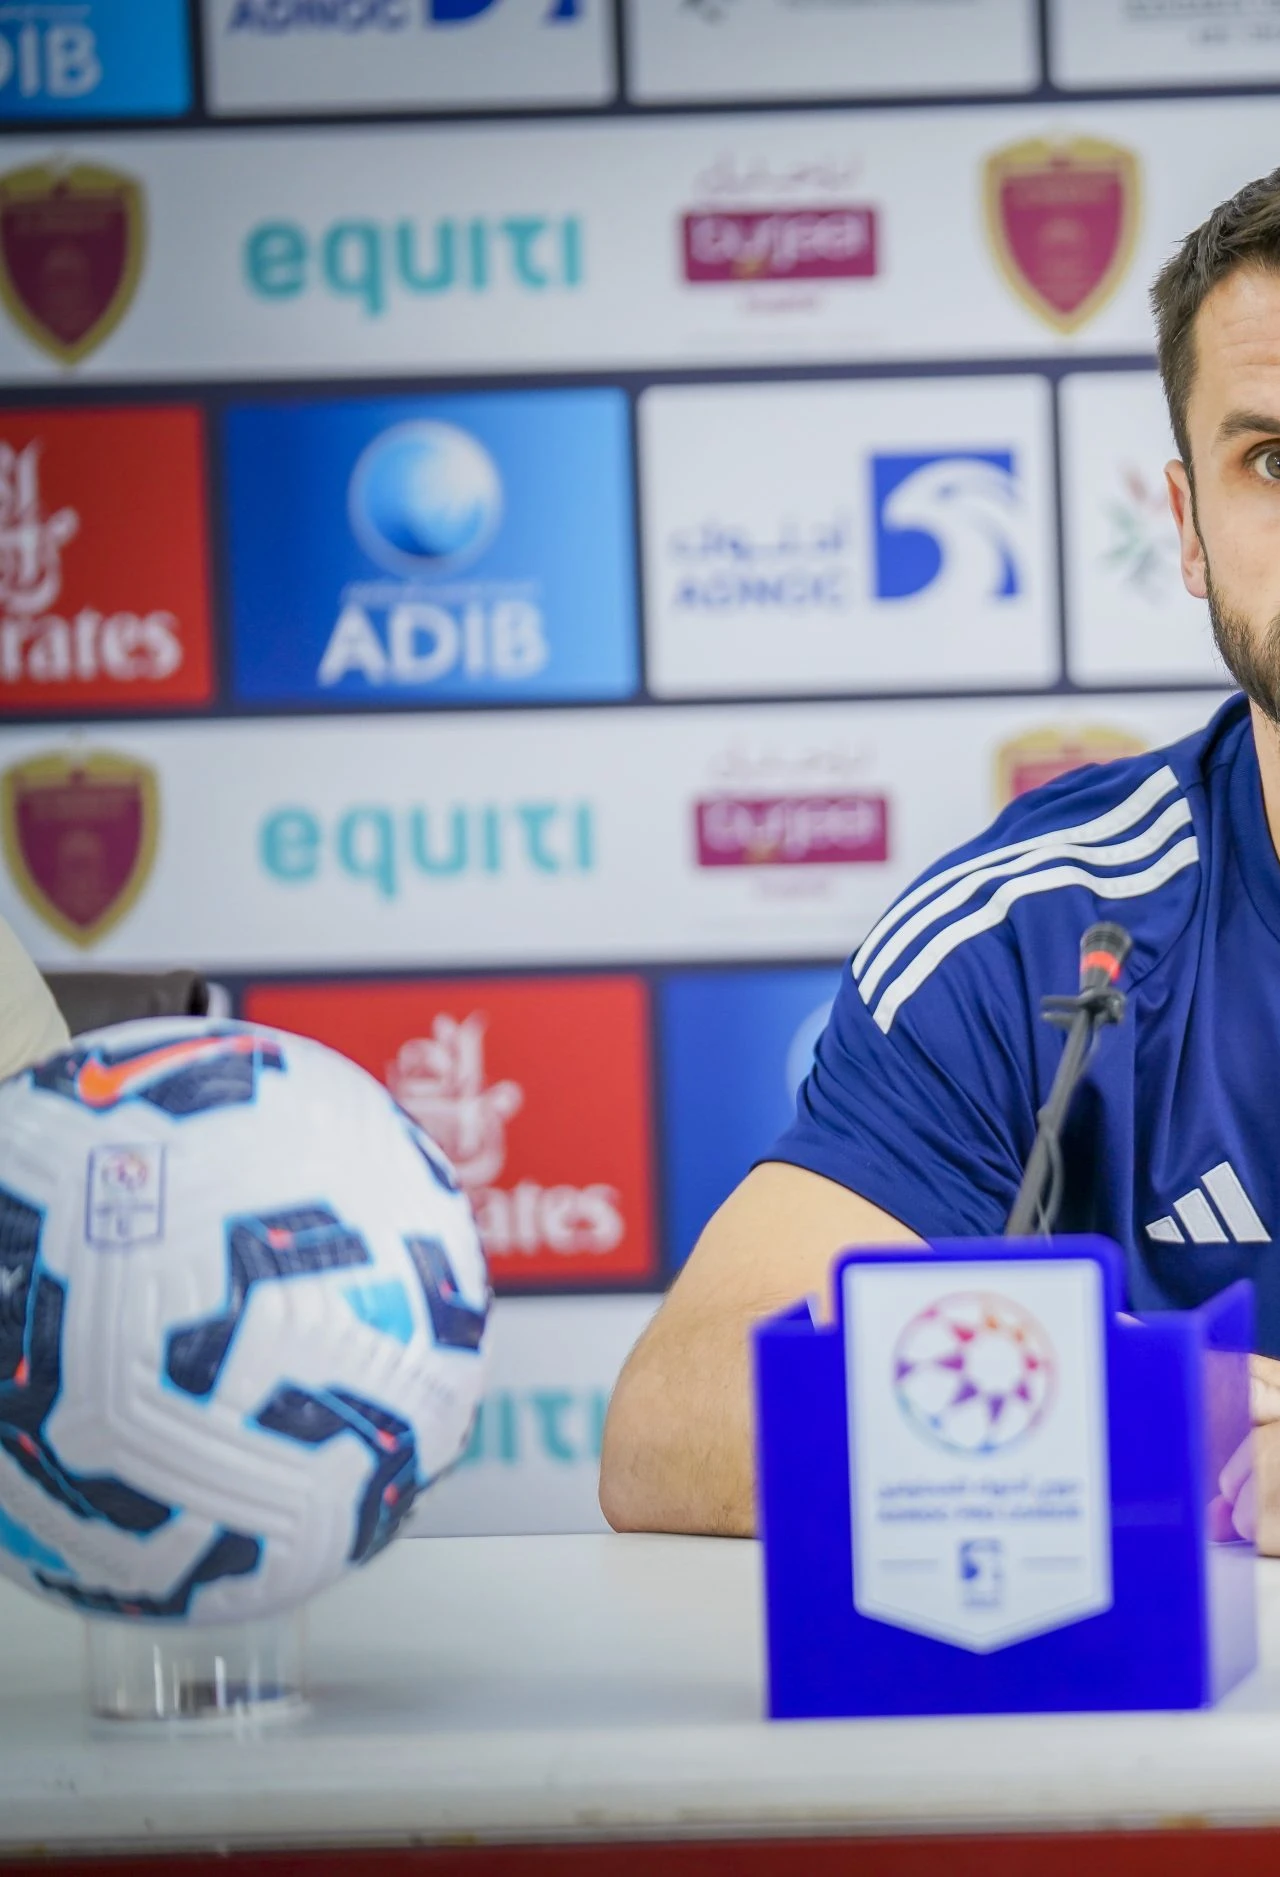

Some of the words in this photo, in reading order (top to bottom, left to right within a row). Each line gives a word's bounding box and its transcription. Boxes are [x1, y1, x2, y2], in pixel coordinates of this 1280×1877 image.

[0, 25, 102, 97] IB
[243, 215, 584, 319] equiti
[317, 599, 551, 688] ADIB
[257, 802, 595, 901] equiti
